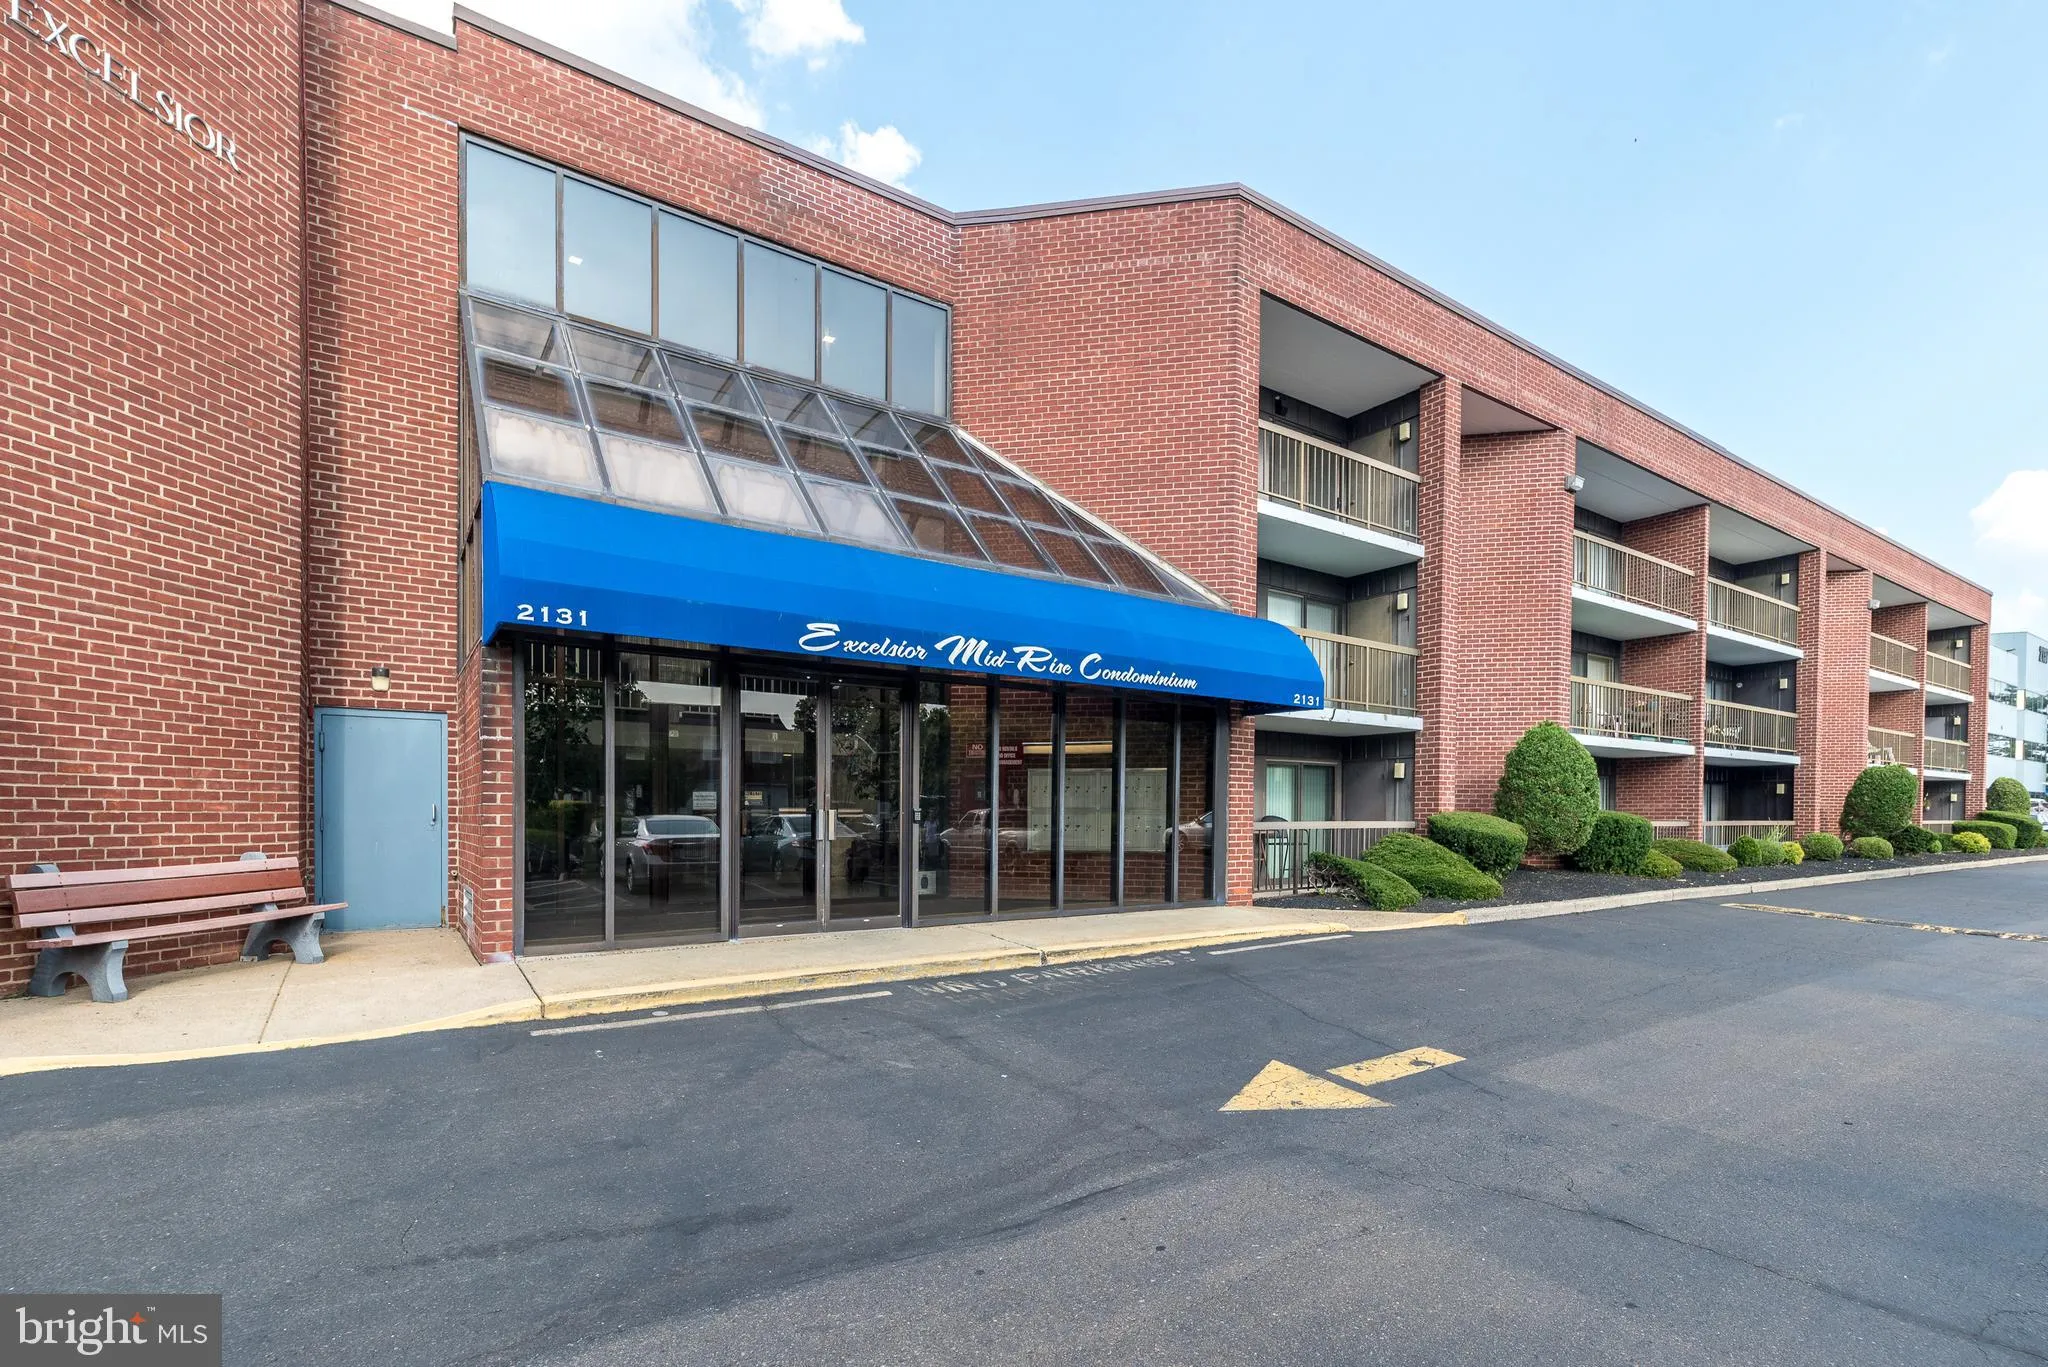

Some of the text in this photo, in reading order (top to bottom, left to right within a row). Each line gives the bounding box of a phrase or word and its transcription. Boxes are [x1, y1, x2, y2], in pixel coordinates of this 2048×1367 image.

[9, 0, 241, 174] EXCELSIOR
[516, 603, 588, 627] 2131
[798, 622, 1198, 690] Excelsior Mid-Rise Condominium
[1293, 693, 1320, 707] 2131
